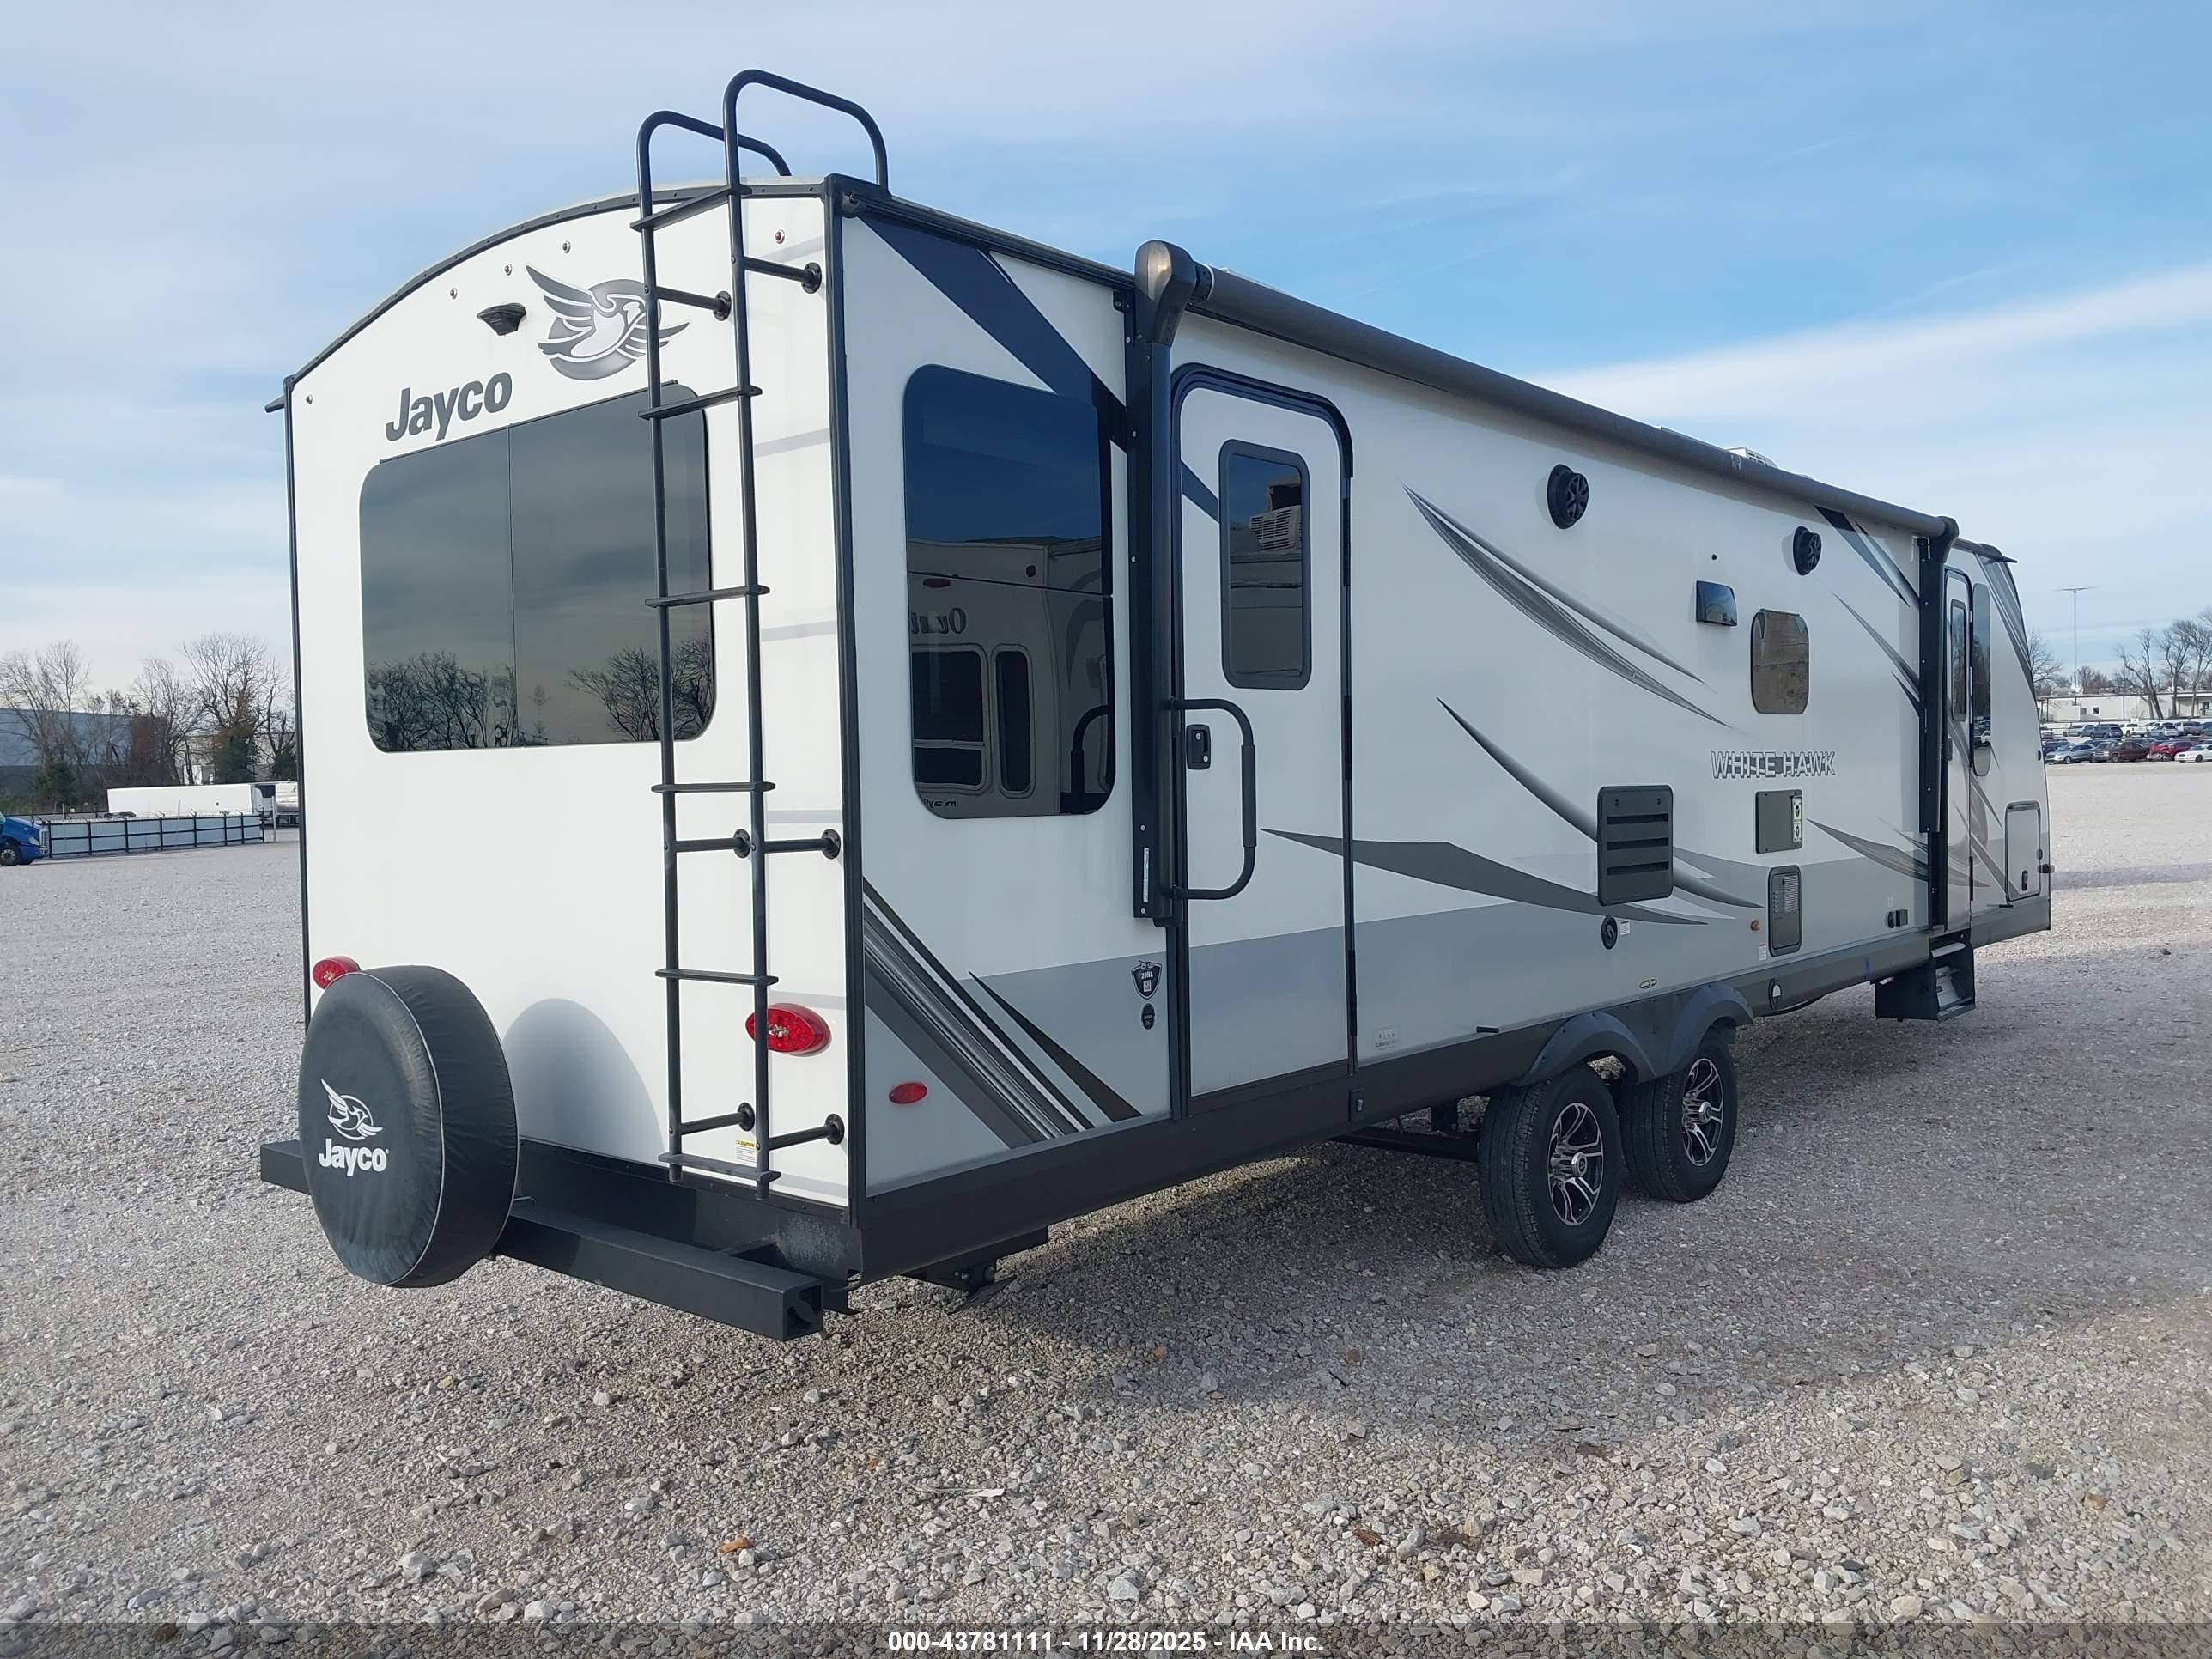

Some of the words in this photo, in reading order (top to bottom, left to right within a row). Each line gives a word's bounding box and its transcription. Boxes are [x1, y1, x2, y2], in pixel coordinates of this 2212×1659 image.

[385, 371, 513, 442] Jayco
[1710, 750, 1777, 779] WHITE
[1782, 750, 1836, 778] HAWK
[318, 1138, 387, 1176] Jayco
